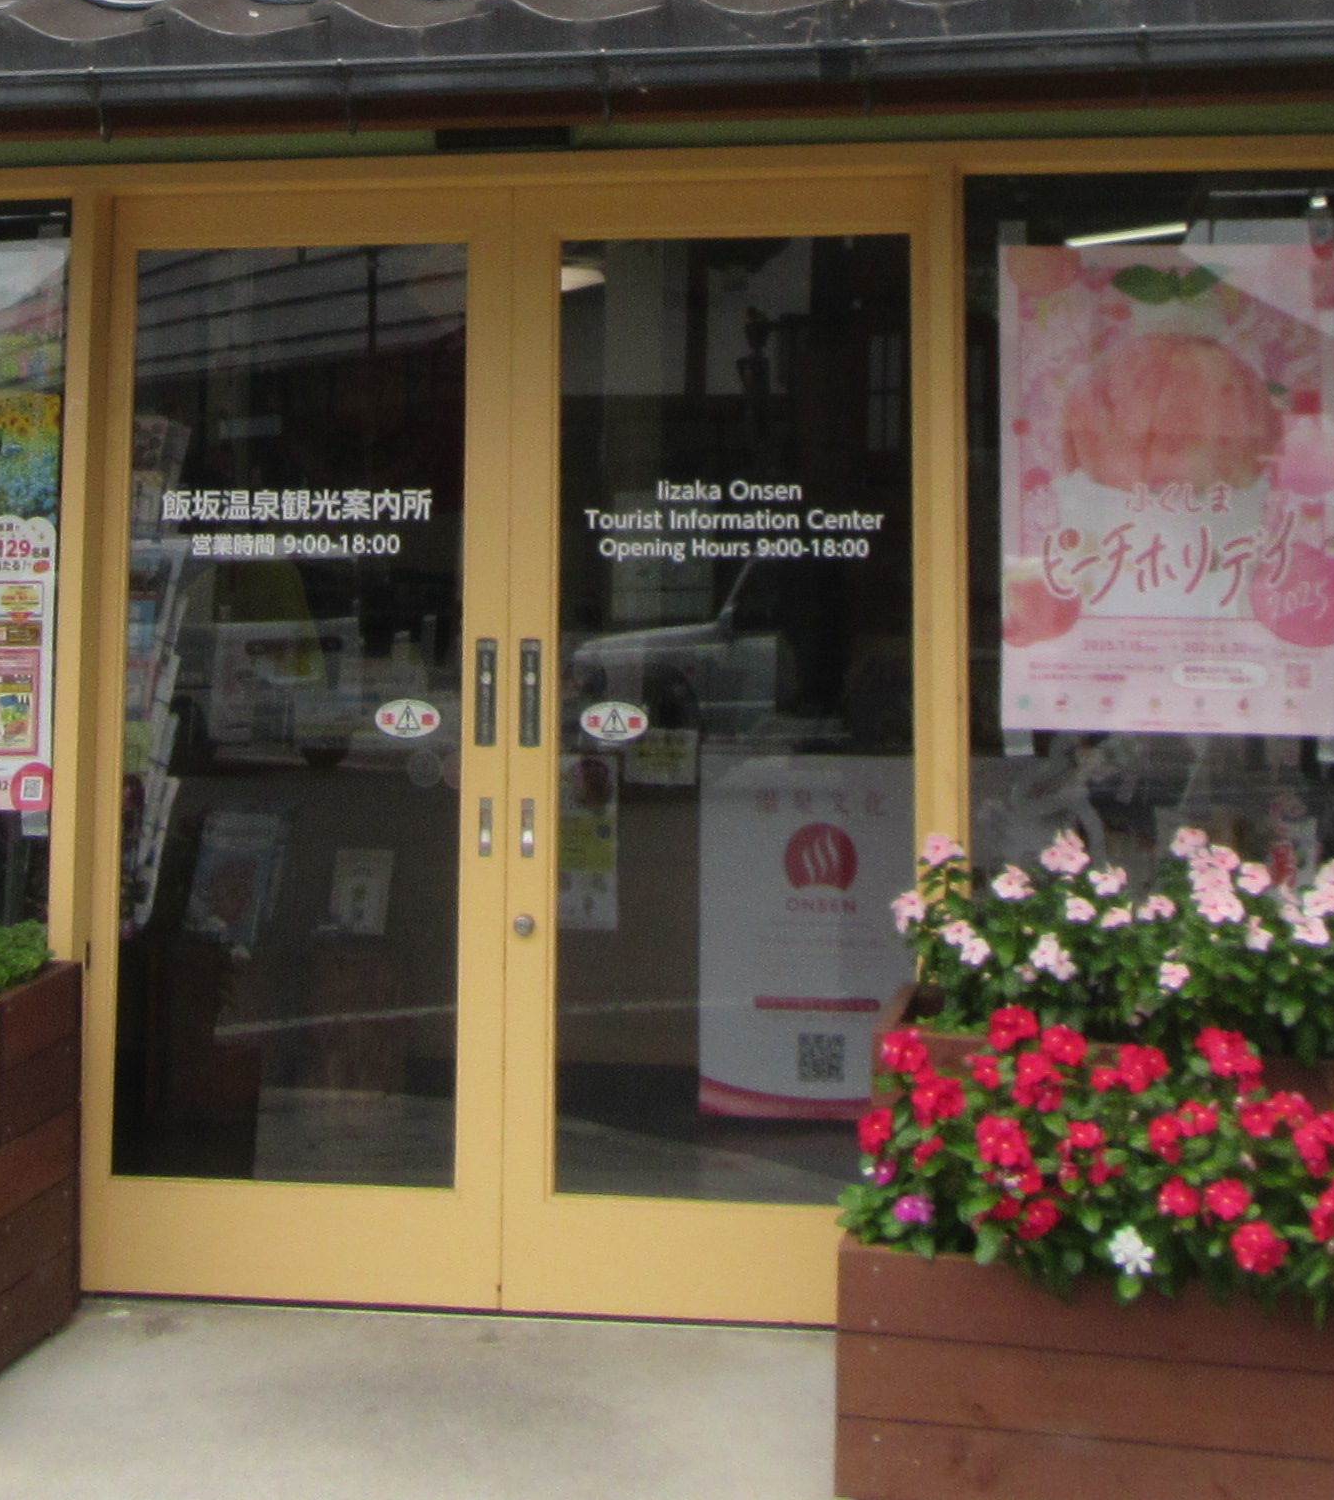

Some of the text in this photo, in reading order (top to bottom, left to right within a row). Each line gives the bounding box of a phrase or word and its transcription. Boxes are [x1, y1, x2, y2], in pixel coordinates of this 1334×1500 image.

[657, 480, 802, 501] Iizaka Onsen
[1126, 482, 1234, 514] ふくしま
[162, 488, 433, 522] 飯坂温泉観光案内所
[585, 509, 885, 531] Tourist Information Center
[192, 534, 401, 556] 営業時間 9:00-18:00
[599, 538, 870, 562] Opening Hours 9:00-18:00
[1043, 510, 1297, 607] ピーチホリデイ
[785, 896, 857, 914] ONSEN
